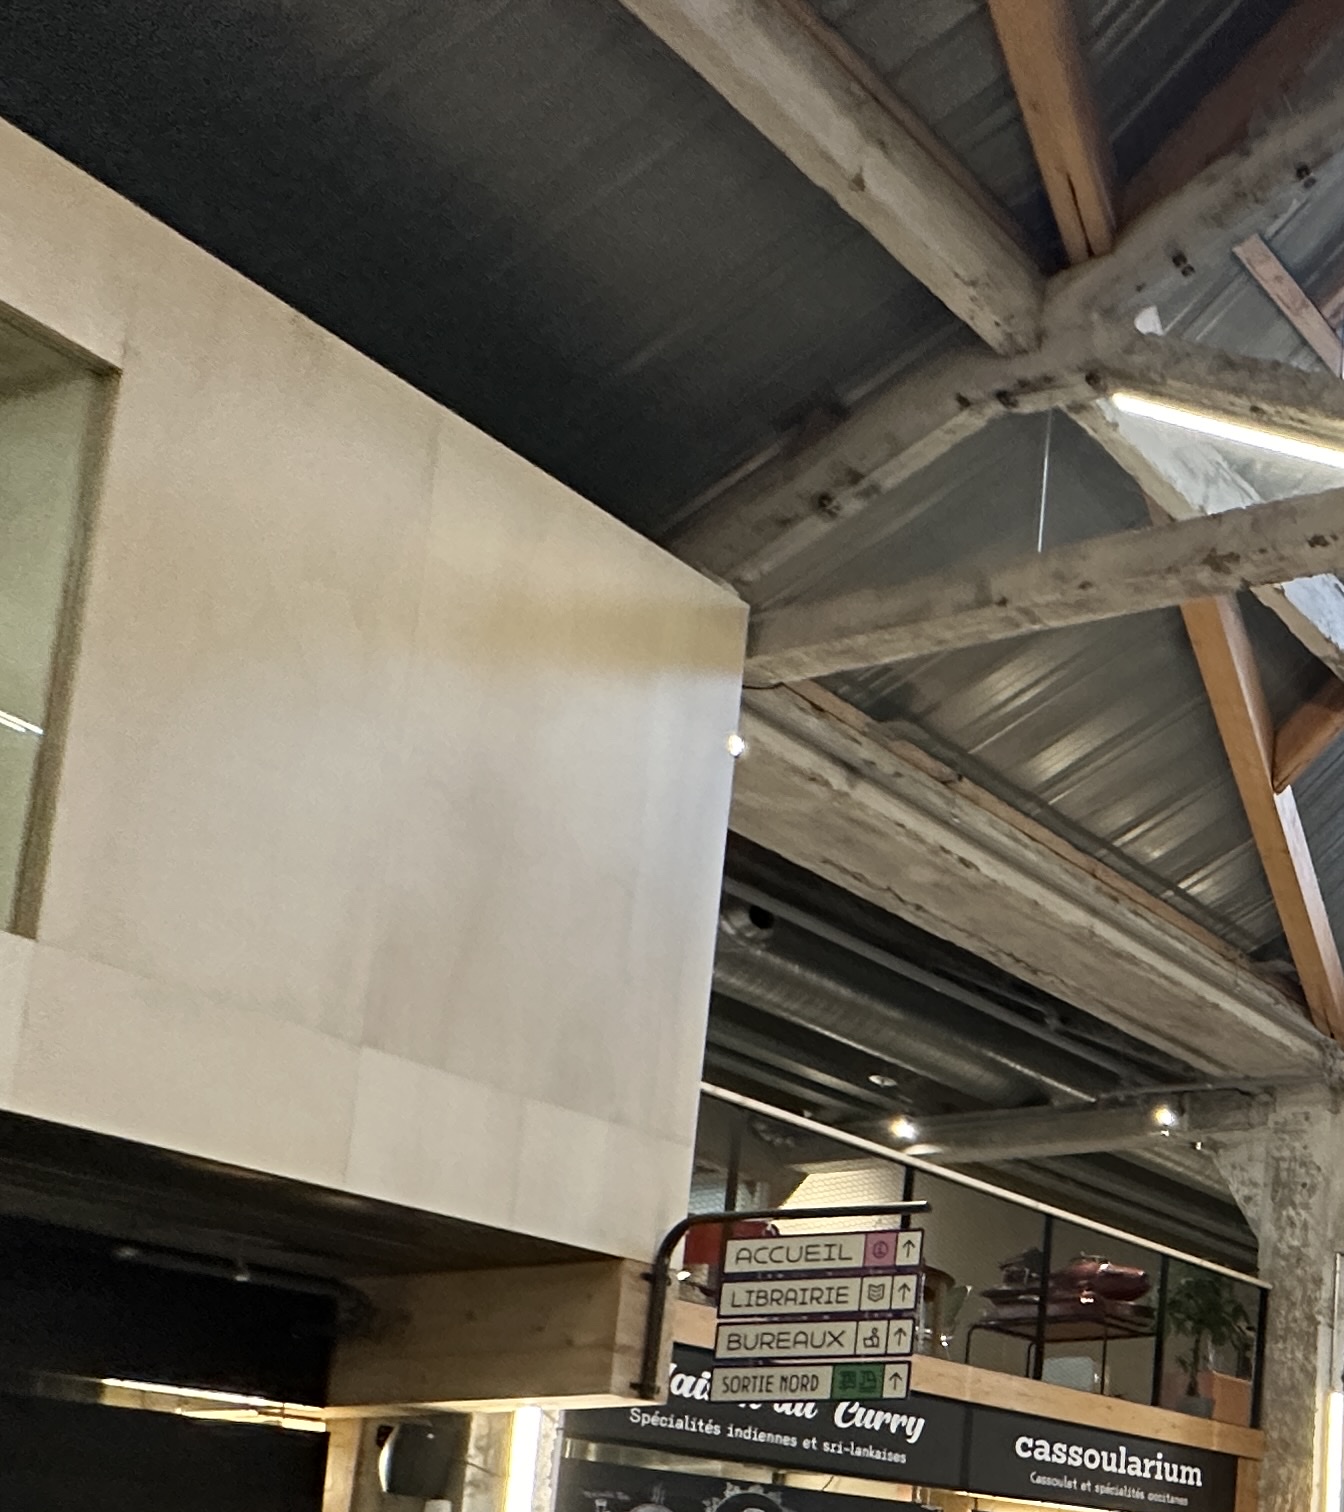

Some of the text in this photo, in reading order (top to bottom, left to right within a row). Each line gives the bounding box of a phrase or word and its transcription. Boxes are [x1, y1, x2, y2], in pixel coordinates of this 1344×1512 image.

[735, 1243, 853, 1266] ACCUEIL
[731, 1285, 850, 1308] LIBRAIRIE
[726, 1329, 846, 1351] BUREAUX
[722, 1375, 774, 1394] SORTIE
[780, 1375, 819, 1394] NORD
[629, 1408, 907, 1463] Spécialités indiennes et sri-lankaises
[833, 1401, 926, 1444] Curry
[1015, 1434, 1203, 1487] cassoularium
[1029, 1471, 1078, 1491] Cassoulet
[1080, 1481, 1092, 1492] et
[1094, 1481, 1145, 1501] spécialités
